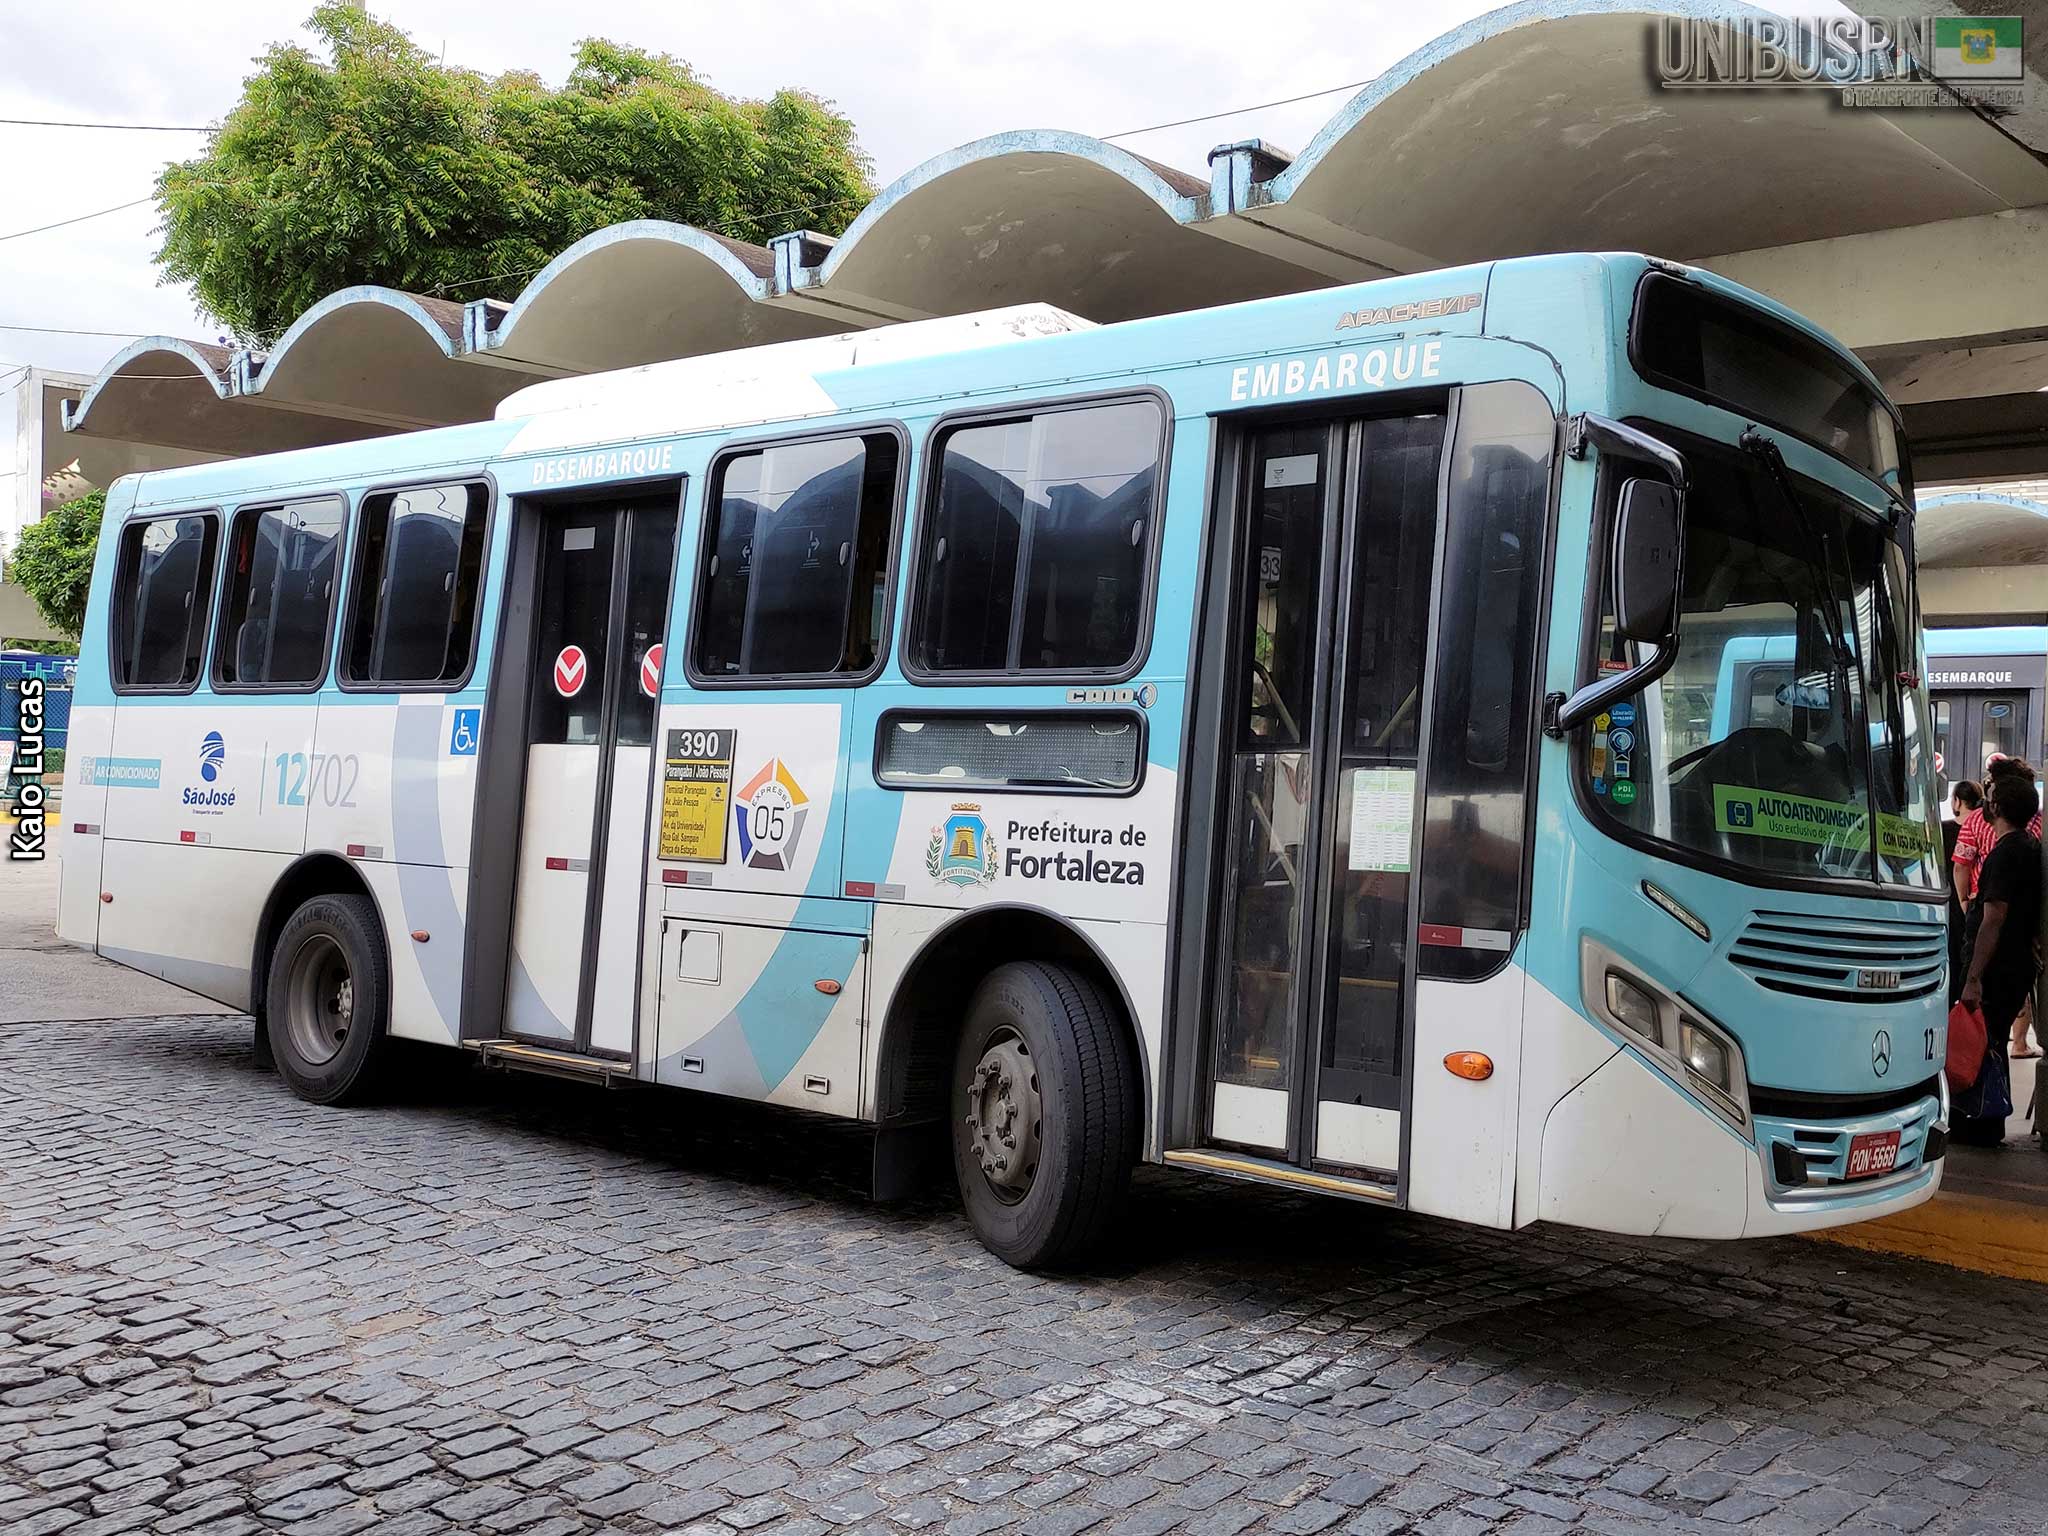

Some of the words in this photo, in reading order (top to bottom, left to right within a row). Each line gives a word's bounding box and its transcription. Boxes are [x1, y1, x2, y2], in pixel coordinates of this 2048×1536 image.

[1231, 341, 1442, 402] EMBARQUE
[532, 445, 673, 485] DESEMBARQUE
[1928, 672, 2012, 683] ESEMBARQUE
[1066, 688, 1135, 704] CAIO
[680, 731, 719, 757] 390
[96, 766, 106, 777] AR
[106, 766, 160, 780] CONDICIONADO
[275, 752, 359, 808] 12702
[754, 805, 785, 841] 05
[1757, 797, 1864, 831] AUTOATENDIMENTO
[1007, 821, 1112, 845] Prefeitura
[1119, 825, 1147, 846] de
[1769, 820, 1783, 833] Uso
[1785, 824, 1818, 839] exclusivo
[1819, 829, 1827, 840] de
[1005, 848, 1145, 885] Fortaleza
